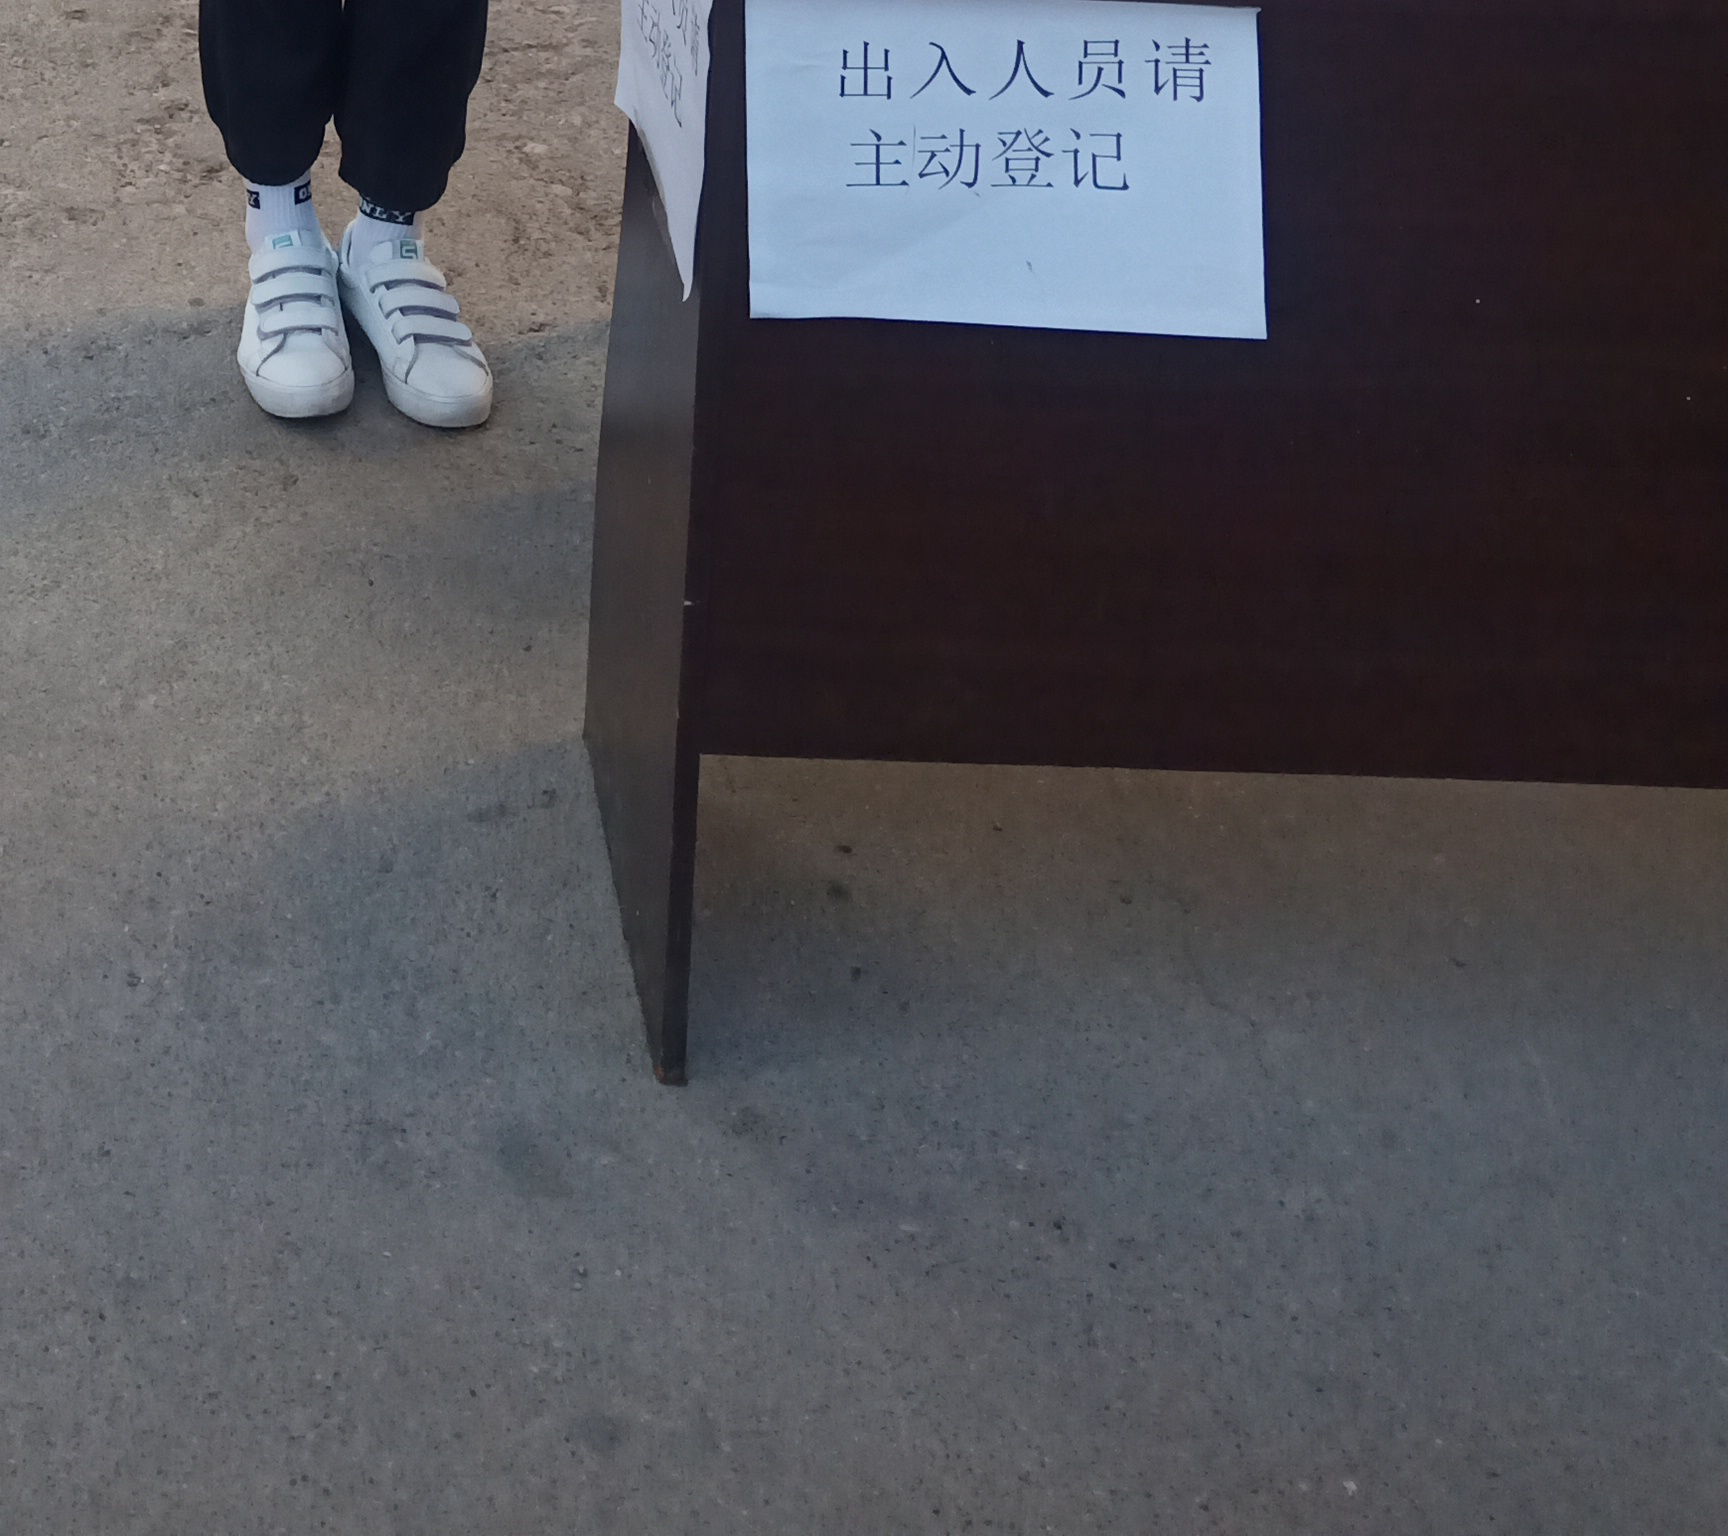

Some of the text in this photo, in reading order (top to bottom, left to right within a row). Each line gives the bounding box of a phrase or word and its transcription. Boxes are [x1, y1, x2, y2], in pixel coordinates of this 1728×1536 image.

[837, 36, 1213, 103] 出入人员请
[845, 128, 1131, 192] 主动登记
